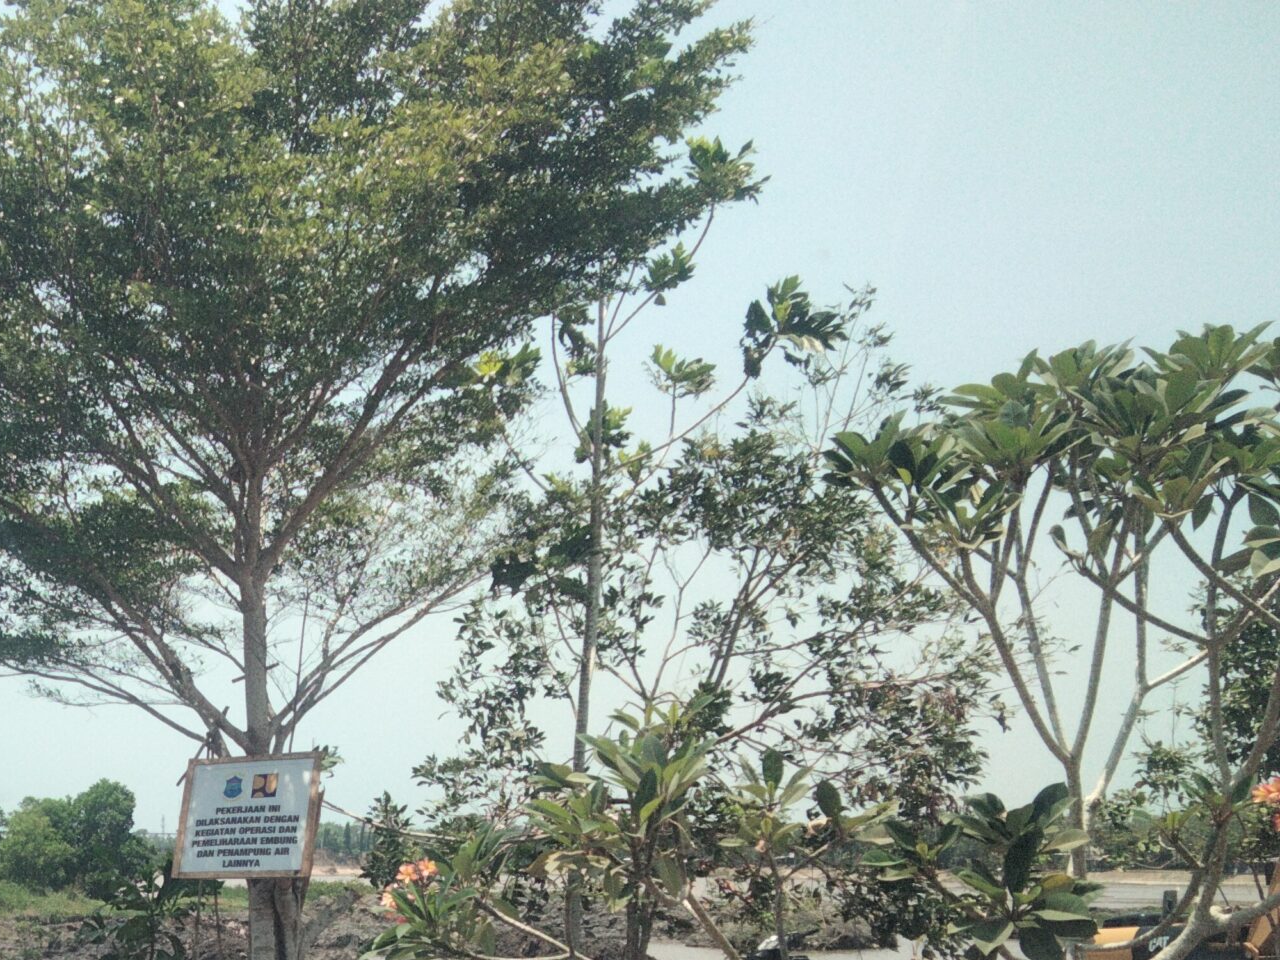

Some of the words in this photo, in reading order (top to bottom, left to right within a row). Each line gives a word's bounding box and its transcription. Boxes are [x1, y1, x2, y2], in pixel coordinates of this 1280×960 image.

[215, 805, 266, 815] PEKERJAAN
[268, 804, 281, 812] INI
[195, 816, 261, 827] DILAKSANAKAN
[263, 815, 300, 823] DENGAN
[194, 827, 236, 837] KEGIATAN
[238, 826, 276, 835] OPERASI
[278, 825, 297, 834] DAN
[191, 837, 258, 848] PEMELIHARAAN
[260, 836, 298, 845] EMBUNG
[196, 850, 214, 858] DAN
[217, 848, 271, 857] PENAMPUNG
[274, 847, 290, 856] AIR
[222, 859, 260, 868] LAINNYA
[1149, 936, 1170, 952] CAT
